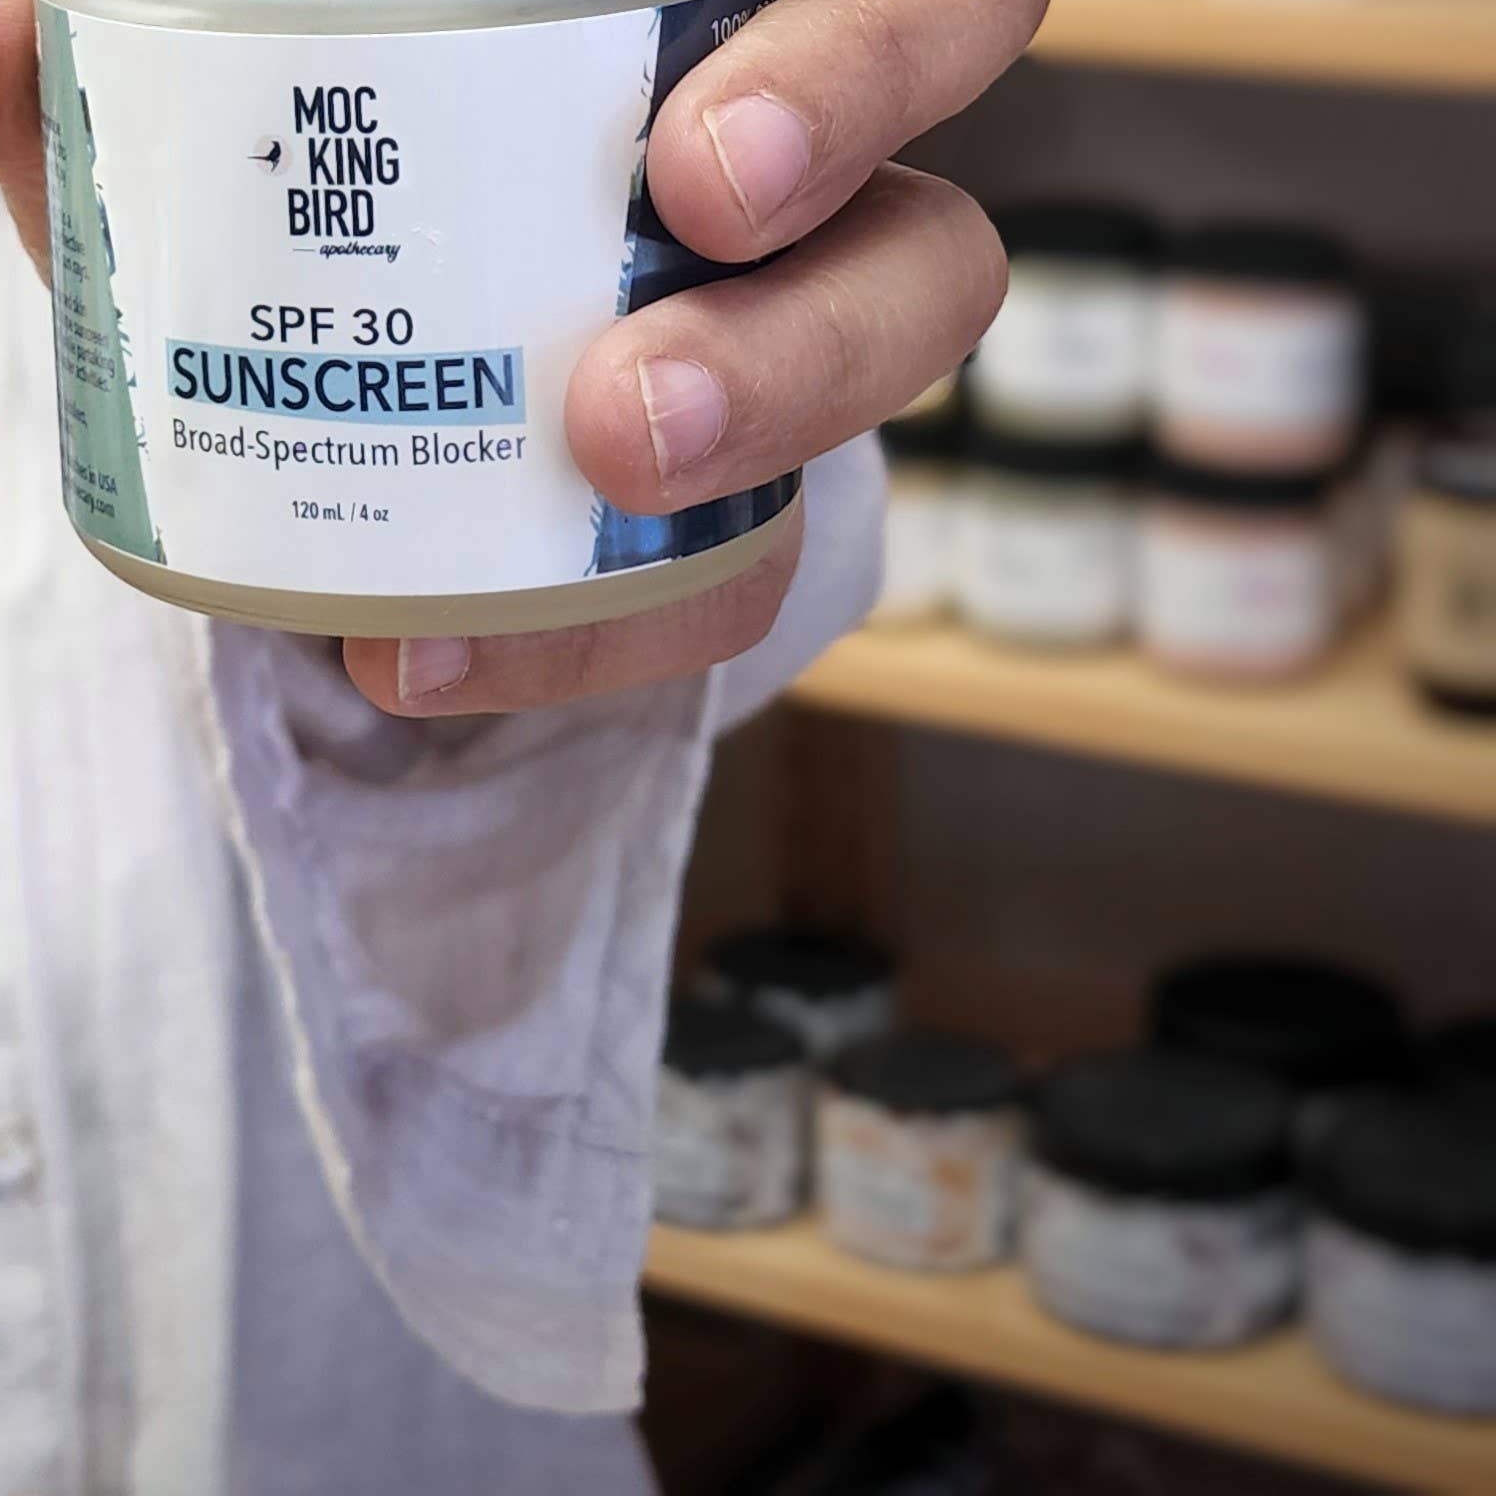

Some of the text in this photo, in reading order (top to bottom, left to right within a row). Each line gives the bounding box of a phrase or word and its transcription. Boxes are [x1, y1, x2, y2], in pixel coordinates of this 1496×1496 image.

[293, 86, 378, 134] MOC
[308, 137, 400, 186] KING
[287, 188, 374, 237] BIRD
[319, 241, 401, 264] apothecary
[250, 304, 414, 346] SPF 30
[173, 347, 514, 412] SUNSCREEN
[172, 418, 527, 470] Broad-Spectrum Blocker
[292, 500, 389, 522] 120 mL / 4 oz
